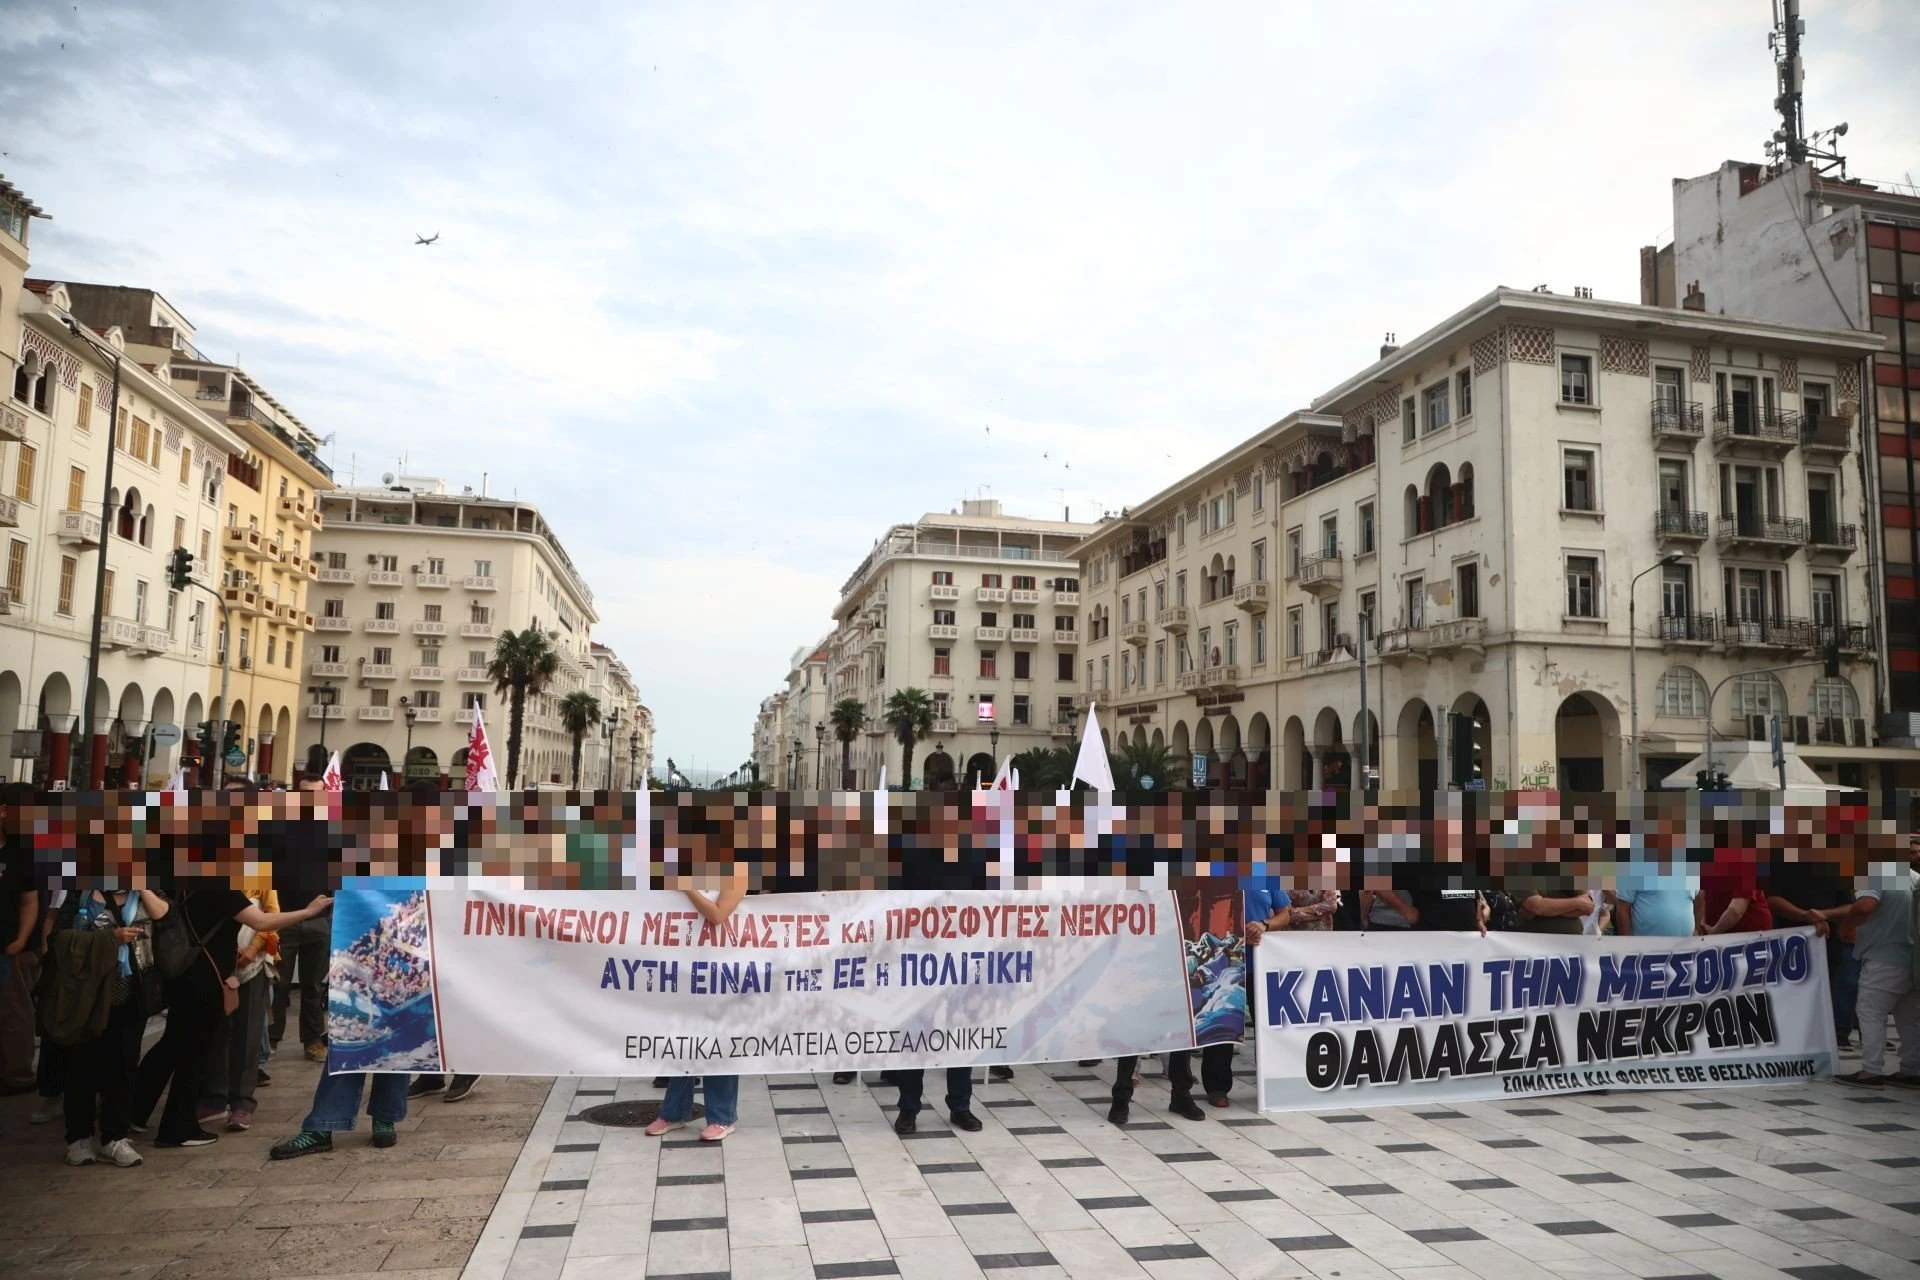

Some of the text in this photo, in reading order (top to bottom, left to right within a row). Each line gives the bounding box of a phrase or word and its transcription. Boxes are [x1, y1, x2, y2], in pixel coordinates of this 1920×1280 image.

[463, 900, 1156, 949] ΠΝΙΓΜΕΝΟΙ ΜΕΤΑΝΑΣΤΕΣ ΚΑΙ ΠΡΟΣΦΥΓΕΣ ΝΕΚΡΟΙ
[600, 950, 1033, 995] ΑΥΤΗ ΕΙΝΑΙ ΤΗΣ ΕΕ Η ΠΟΛΙΤΙΚΗ
[1265, 934, 1808, 1026] ΚΑΝΑΝ ΤΗΝ ΜΕΣΟΓΕΙΟ
[625, 1027, 1008, 1060] ΕΡΓΑΤΙΚΑ ΣΩΜΑΤΕΙΑ ΘΕΣΣΑΛΟΝΙΚΗΣ
[1305, 992, 1776, 1091] ΘΑΛΑΣΣΑ ΝΕΚΡΩΝ
[1502, 1058, 1817, 1093] ΣΩΜΑΤΕΙΑ ΚΑΙ ΦΟΡΕΙΣ ΕΒΕ ΘΕΣΣΑΛΟΝΙΚΗΣ
